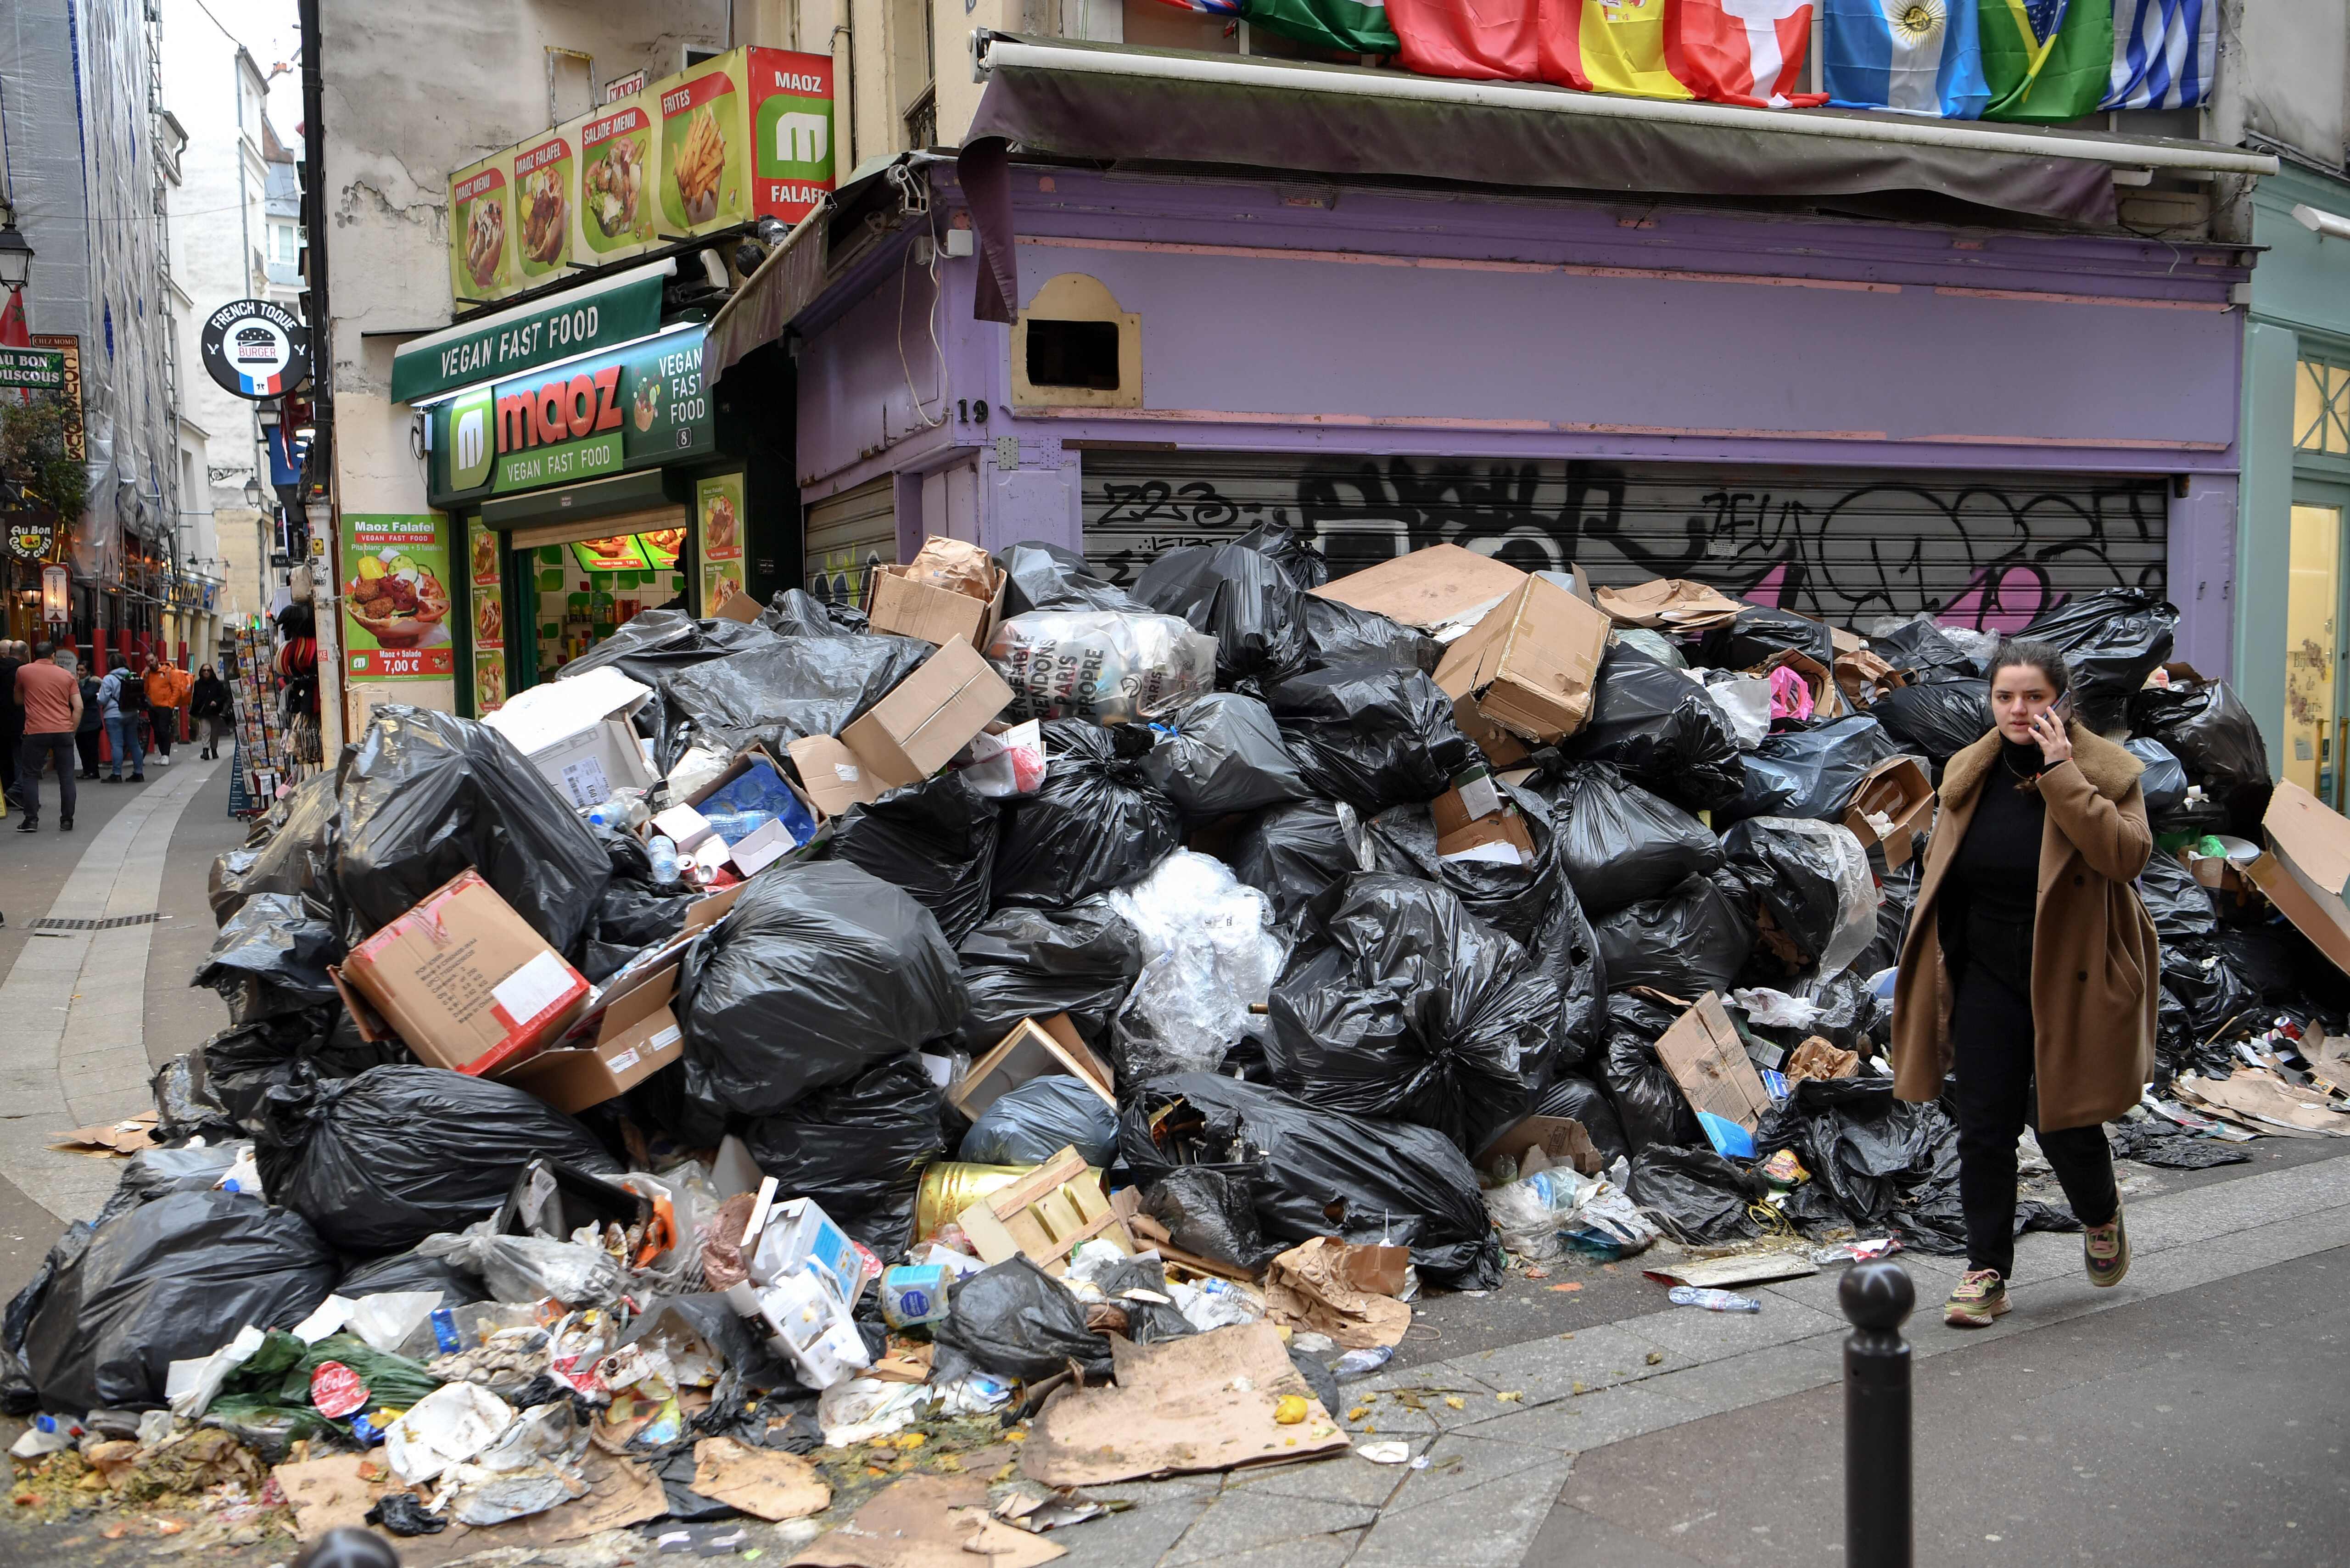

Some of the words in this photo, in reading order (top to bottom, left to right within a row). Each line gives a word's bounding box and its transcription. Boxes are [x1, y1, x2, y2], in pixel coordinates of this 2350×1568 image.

[610, 79, 641, 102] MAOZ
[775, 71, 822, 93] MAOZ
[663, 89, 690, 114] FRITES
[584, 121, 611, 145] SALADE
[613, 111, 636, 134] MENU
[516, 154, 534, 175] MAOZ
[535, 142, 561, 166] FALAFEL
[456, 182, 472, 201] MAOZ
[473, 174, 490, 193] MENU
[211, 302, 255, 330] FRENCH
[260, 303, 298, 332] TOQUE
[239, 347, 275, 357] BURGER
[442, 337, 493, 378] VEGAN
[499, 322, 542, 362] FAST
[549, 306, 598, 348] FOOD
[19, 355, 48, 367] BON
[659, 347, 703, 378] VEGAN
[672, 373, 702, 400] FAST
[497, 364, 623, 454] maoz
[671, 398, 705, 425] FOOD
[957, 399, 988, 423] 19
[681, 431, 687, 445] 8
[507, 459, 540, 482] VEGAN
[548, 452, 573, 475] FAST
[581, 445, 610, 468] FOOD
[355, 521, 389, 532] Maoz
[392, 521, 435, 532] Falafel
[384, 660, 408, 675] 7,00
[411, 660, 419, 672] €
[1030, 638, 1058, 719] RENDONS
[1054, 655, 1078, 706] PARIS
[1078, 648, 1105, 716] PROPRE
[1146, 671, 1162, 708] PARIS
[2306, 676, 2315, 690] de
[478, 995, 495, 1009] China
